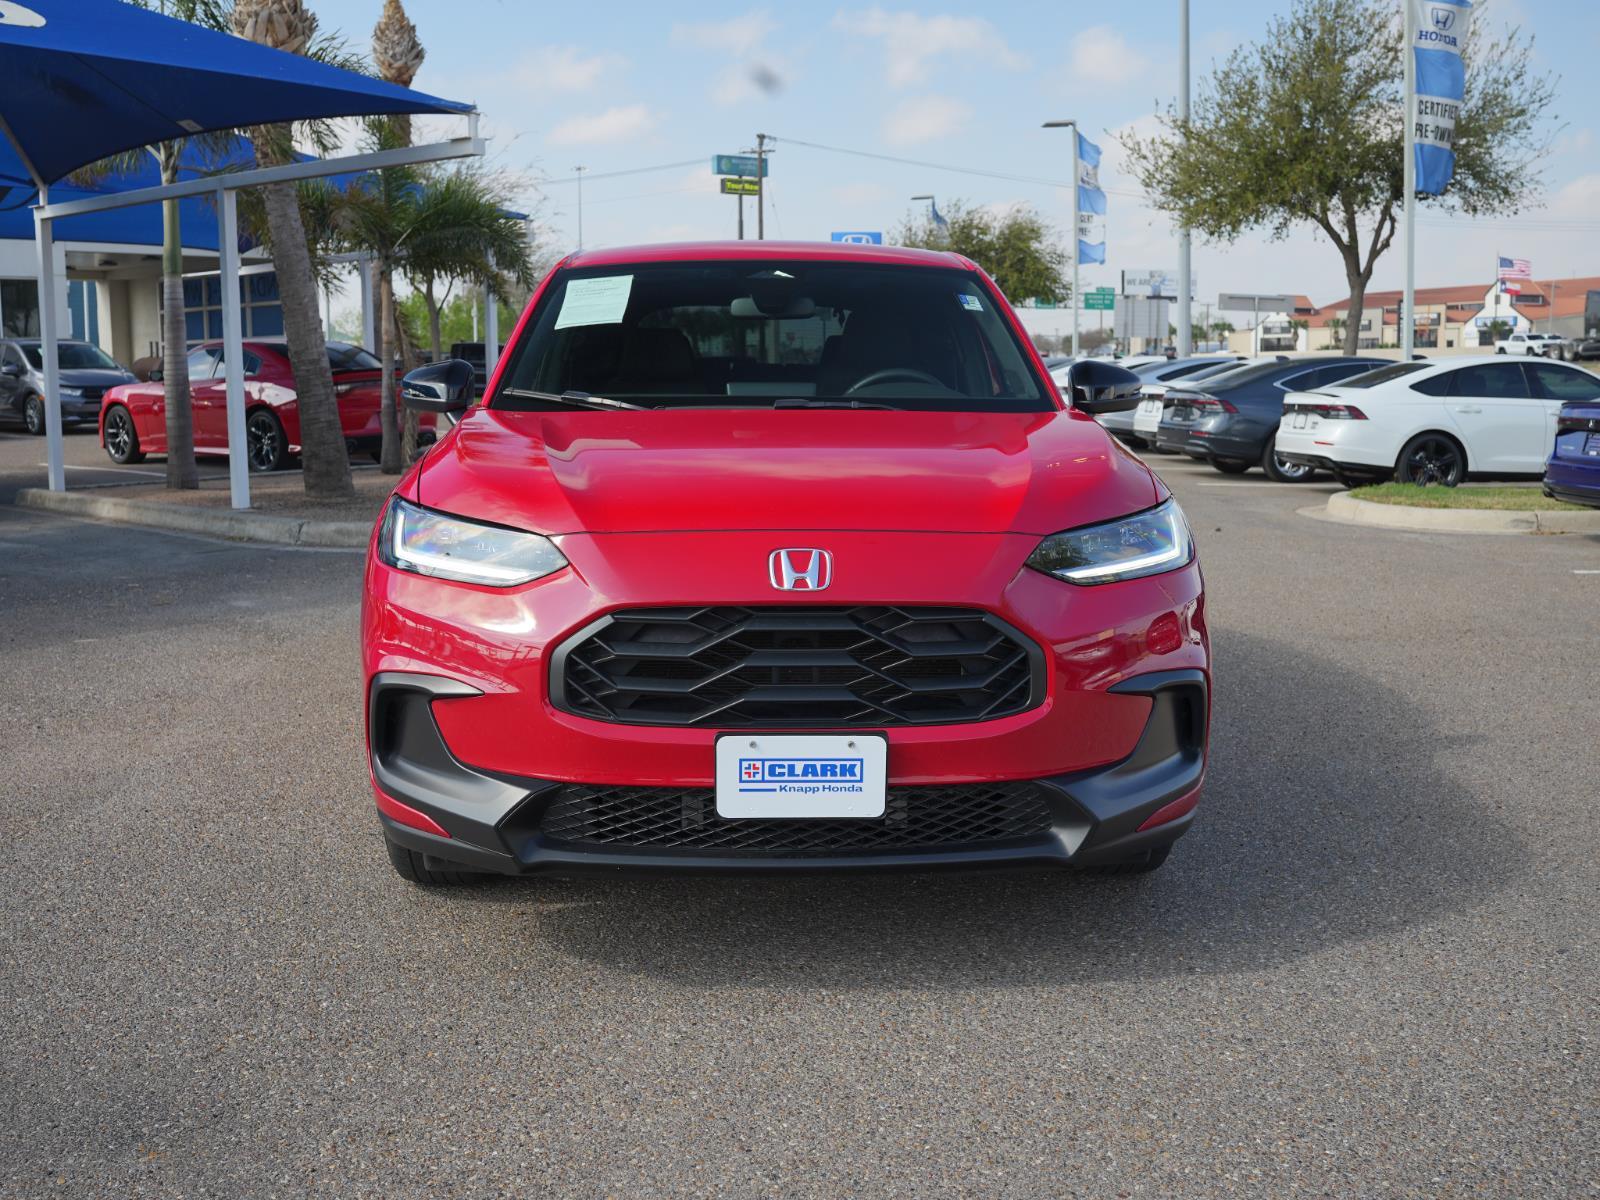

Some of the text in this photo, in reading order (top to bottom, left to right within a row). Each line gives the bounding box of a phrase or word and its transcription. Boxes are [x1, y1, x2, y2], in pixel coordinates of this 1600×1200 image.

[1418, 30, 1458, 47] HONDA
[768, 763, 857, 778] CLARK
[779, 784, 863, 795] Knapp Honda
